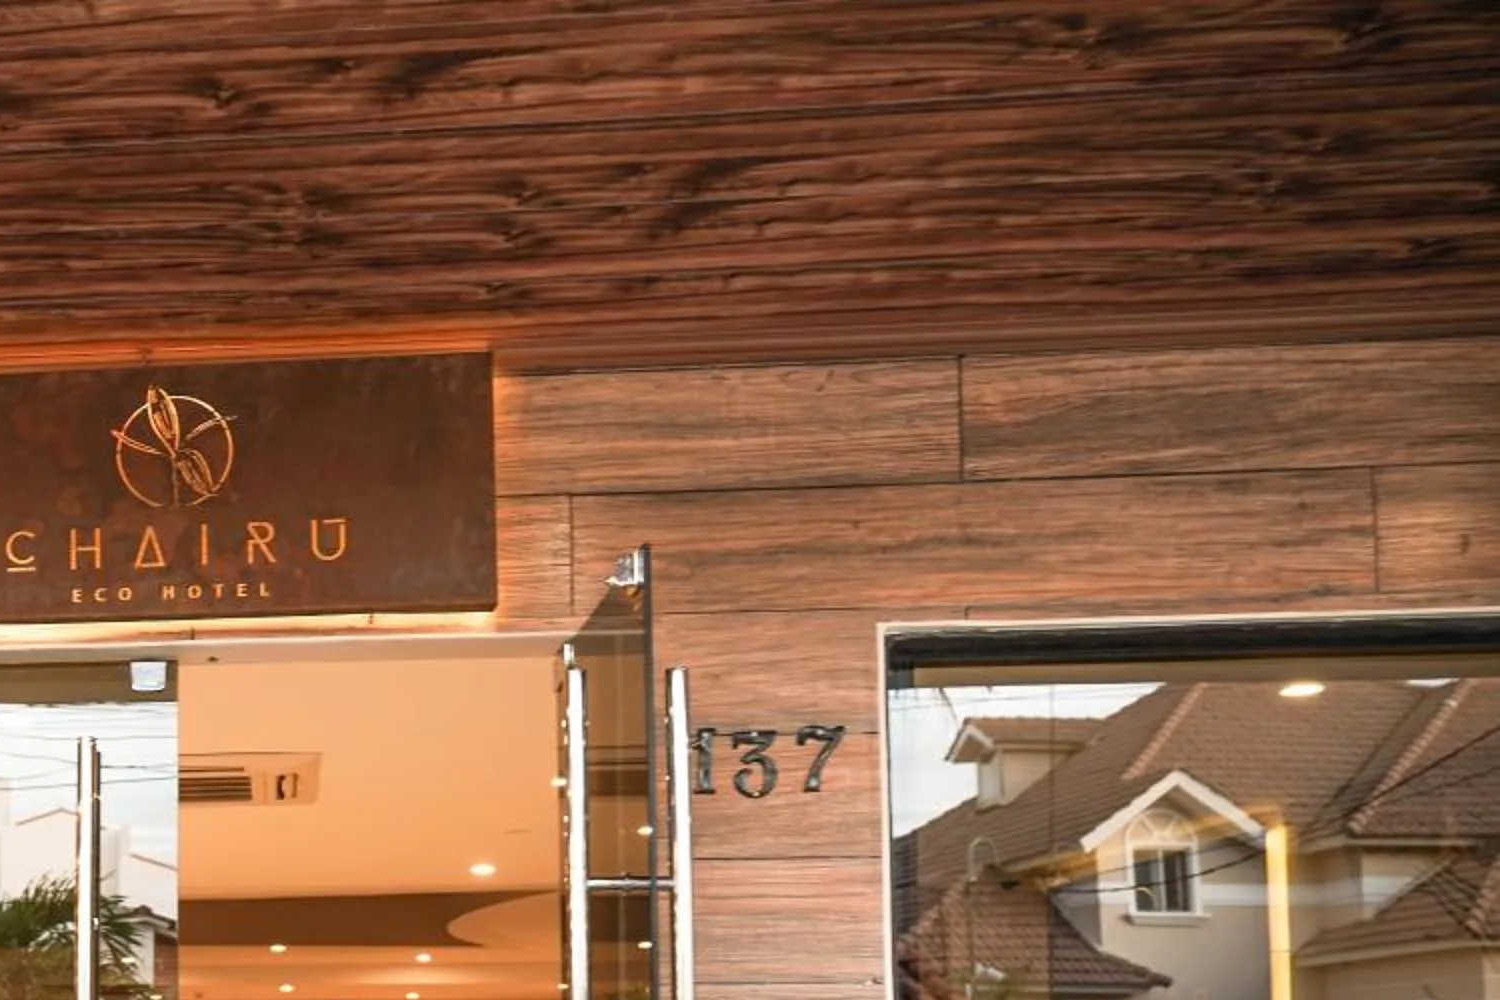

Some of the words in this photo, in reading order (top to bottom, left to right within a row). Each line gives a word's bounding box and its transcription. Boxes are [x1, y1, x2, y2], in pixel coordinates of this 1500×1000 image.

[5, 518, 348, 573] CHAIRU
[71, 587, 133, 604] ECO
[163, 581, 272, 600] HOTEL
[691, 725, 848, 799] 137
